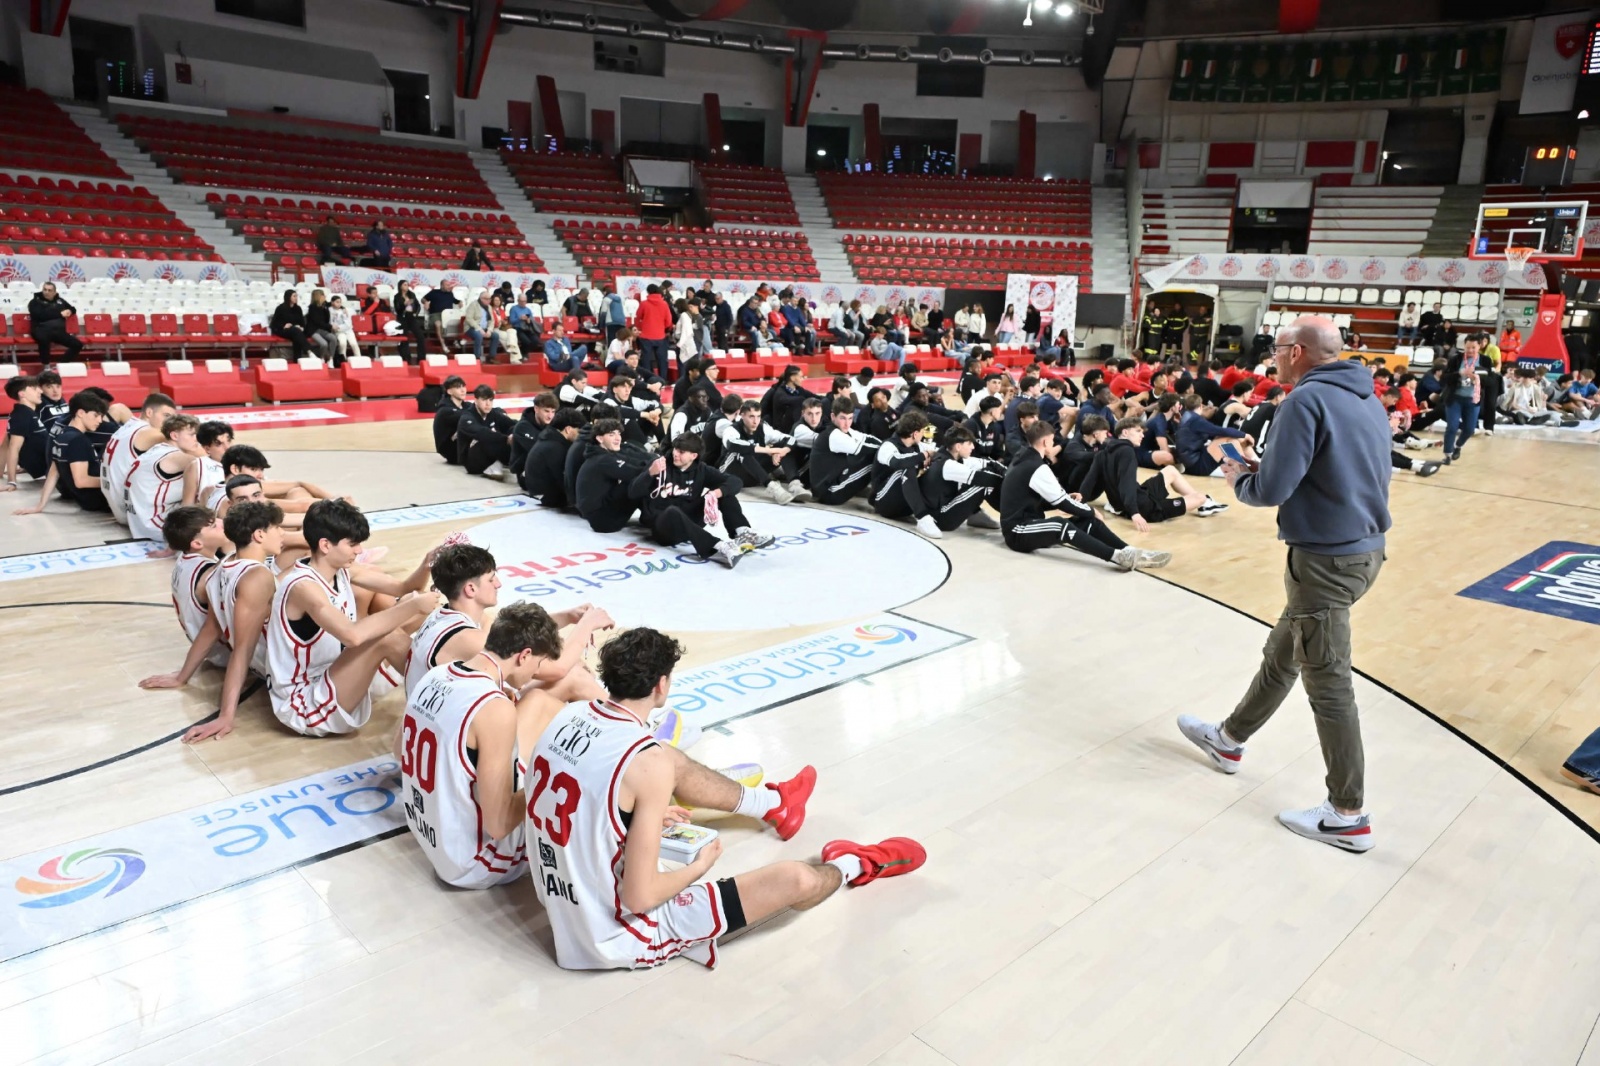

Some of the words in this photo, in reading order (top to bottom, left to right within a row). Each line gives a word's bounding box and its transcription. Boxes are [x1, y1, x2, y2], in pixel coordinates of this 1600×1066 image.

[762, 635, 839, 659] ENERGIA
[671, 670, 718, 687] UNIS
[720, 658, 760, 673] CHE
[401, 713, 438, 794] 30
[190, 783, 325, 828] UNISCE
[527, 754, 582, 847] 23
